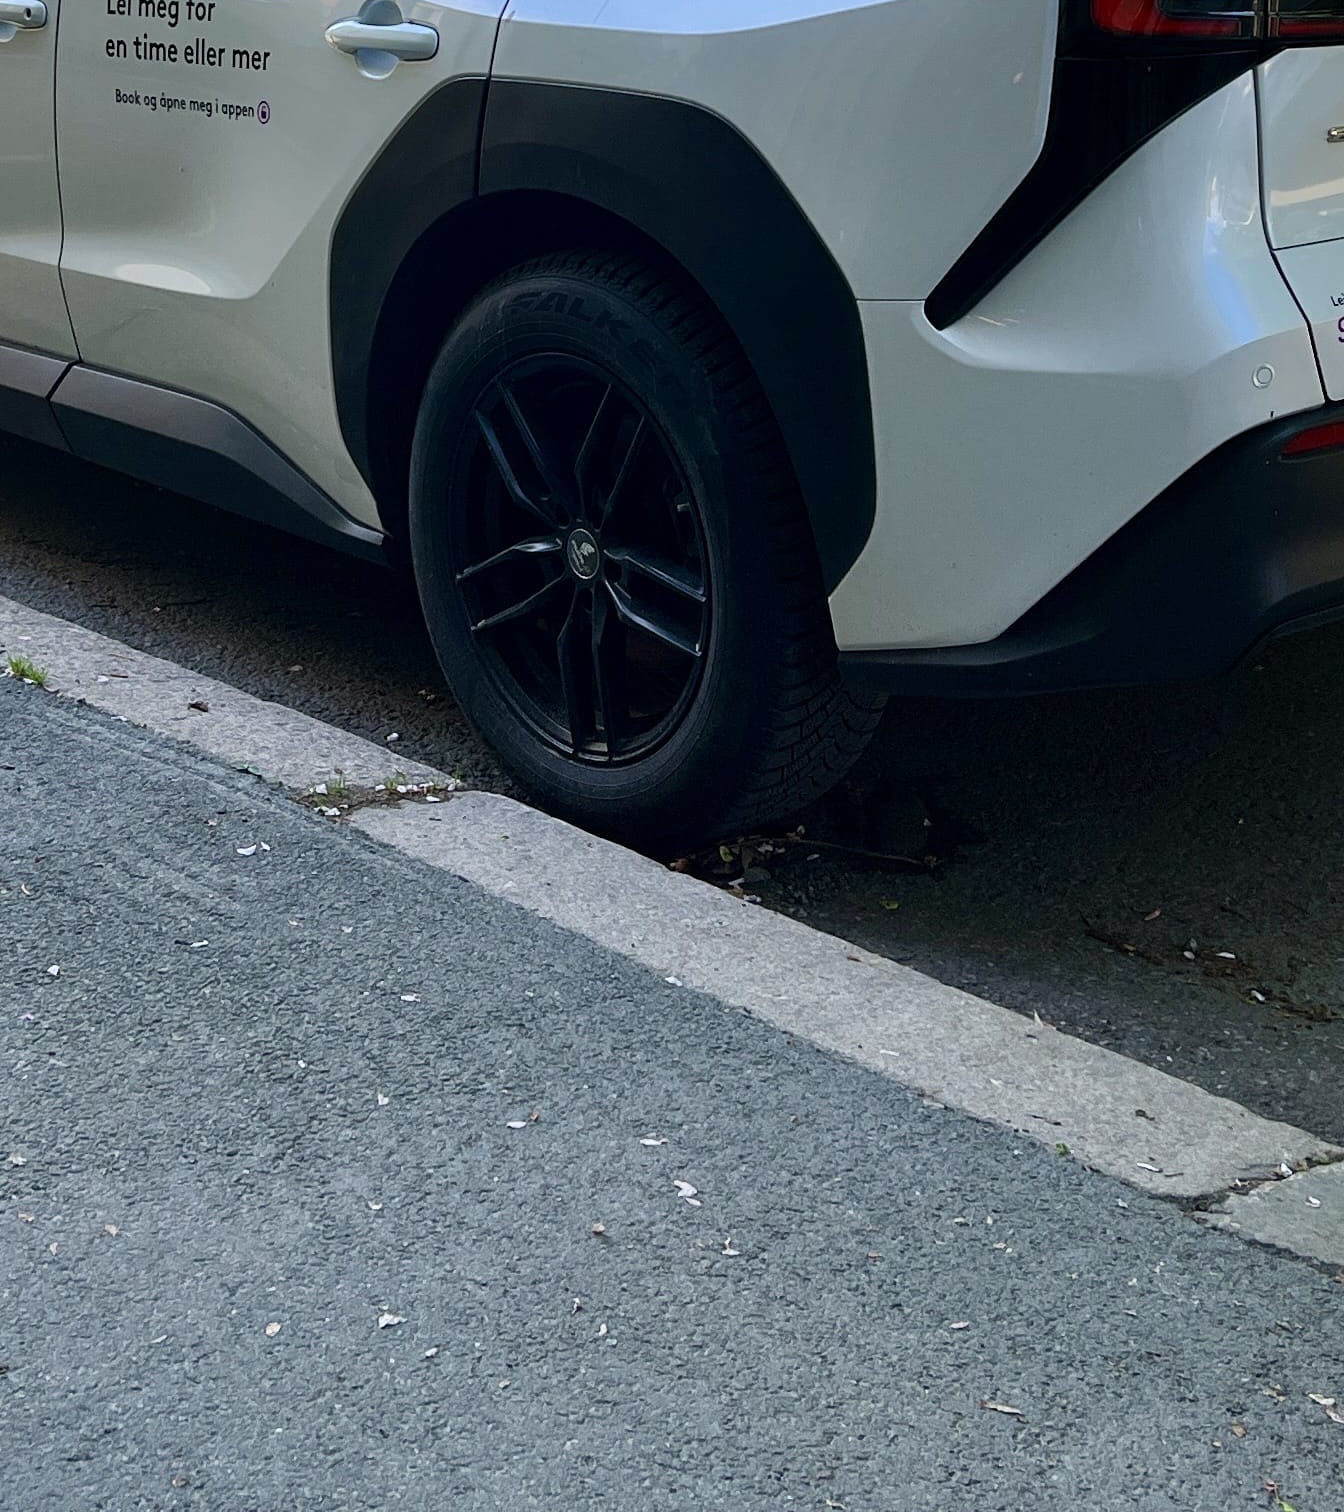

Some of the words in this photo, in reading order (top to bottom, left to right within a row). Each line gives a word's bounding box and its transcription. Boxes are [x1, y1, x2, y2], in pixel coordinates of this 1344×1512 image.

[106, 39, 127, 59] en
[133, 33, 178, 63] time
[184, 38, 225, 67] eller
[232, 48, 271, 71] mer
[115, 89, 141, 106] Book
[143, 95, 157, 111] og
[160, 92, 187, 112] åpne
[189, 100, 212, 118] meg
[215, 98, 219, 114] i
[221, 103, 255, 121] appen
